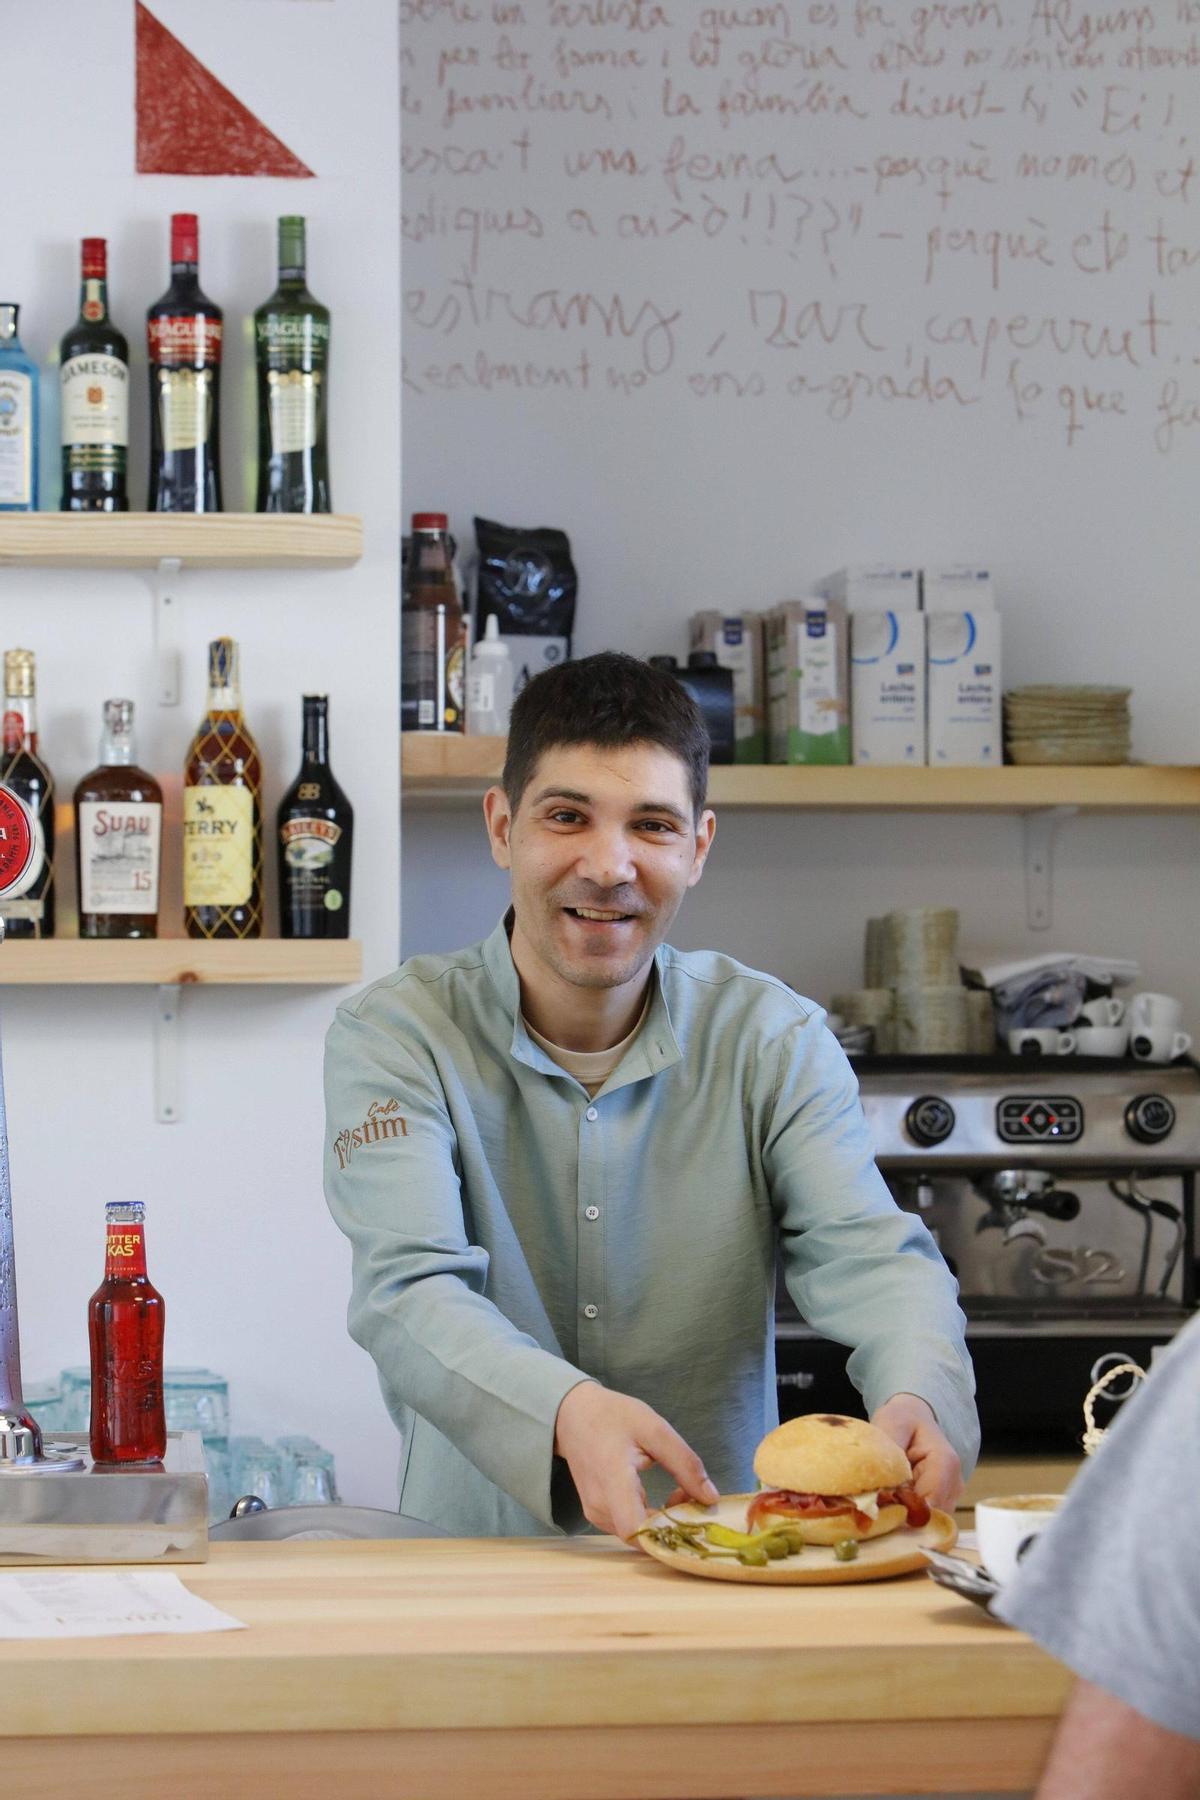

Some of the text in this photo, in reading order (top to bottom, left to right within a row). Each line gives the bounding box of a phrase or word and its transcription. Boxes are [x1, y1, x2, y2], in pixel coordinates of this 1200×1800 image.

[566, 206, 597, 239] a
[62, 360, 128, 384] JAMESON
[1056, 382, 1128, 447] que
[133, 870, 152, 892] 15
[107, 1244, 135, 1257] KAS
